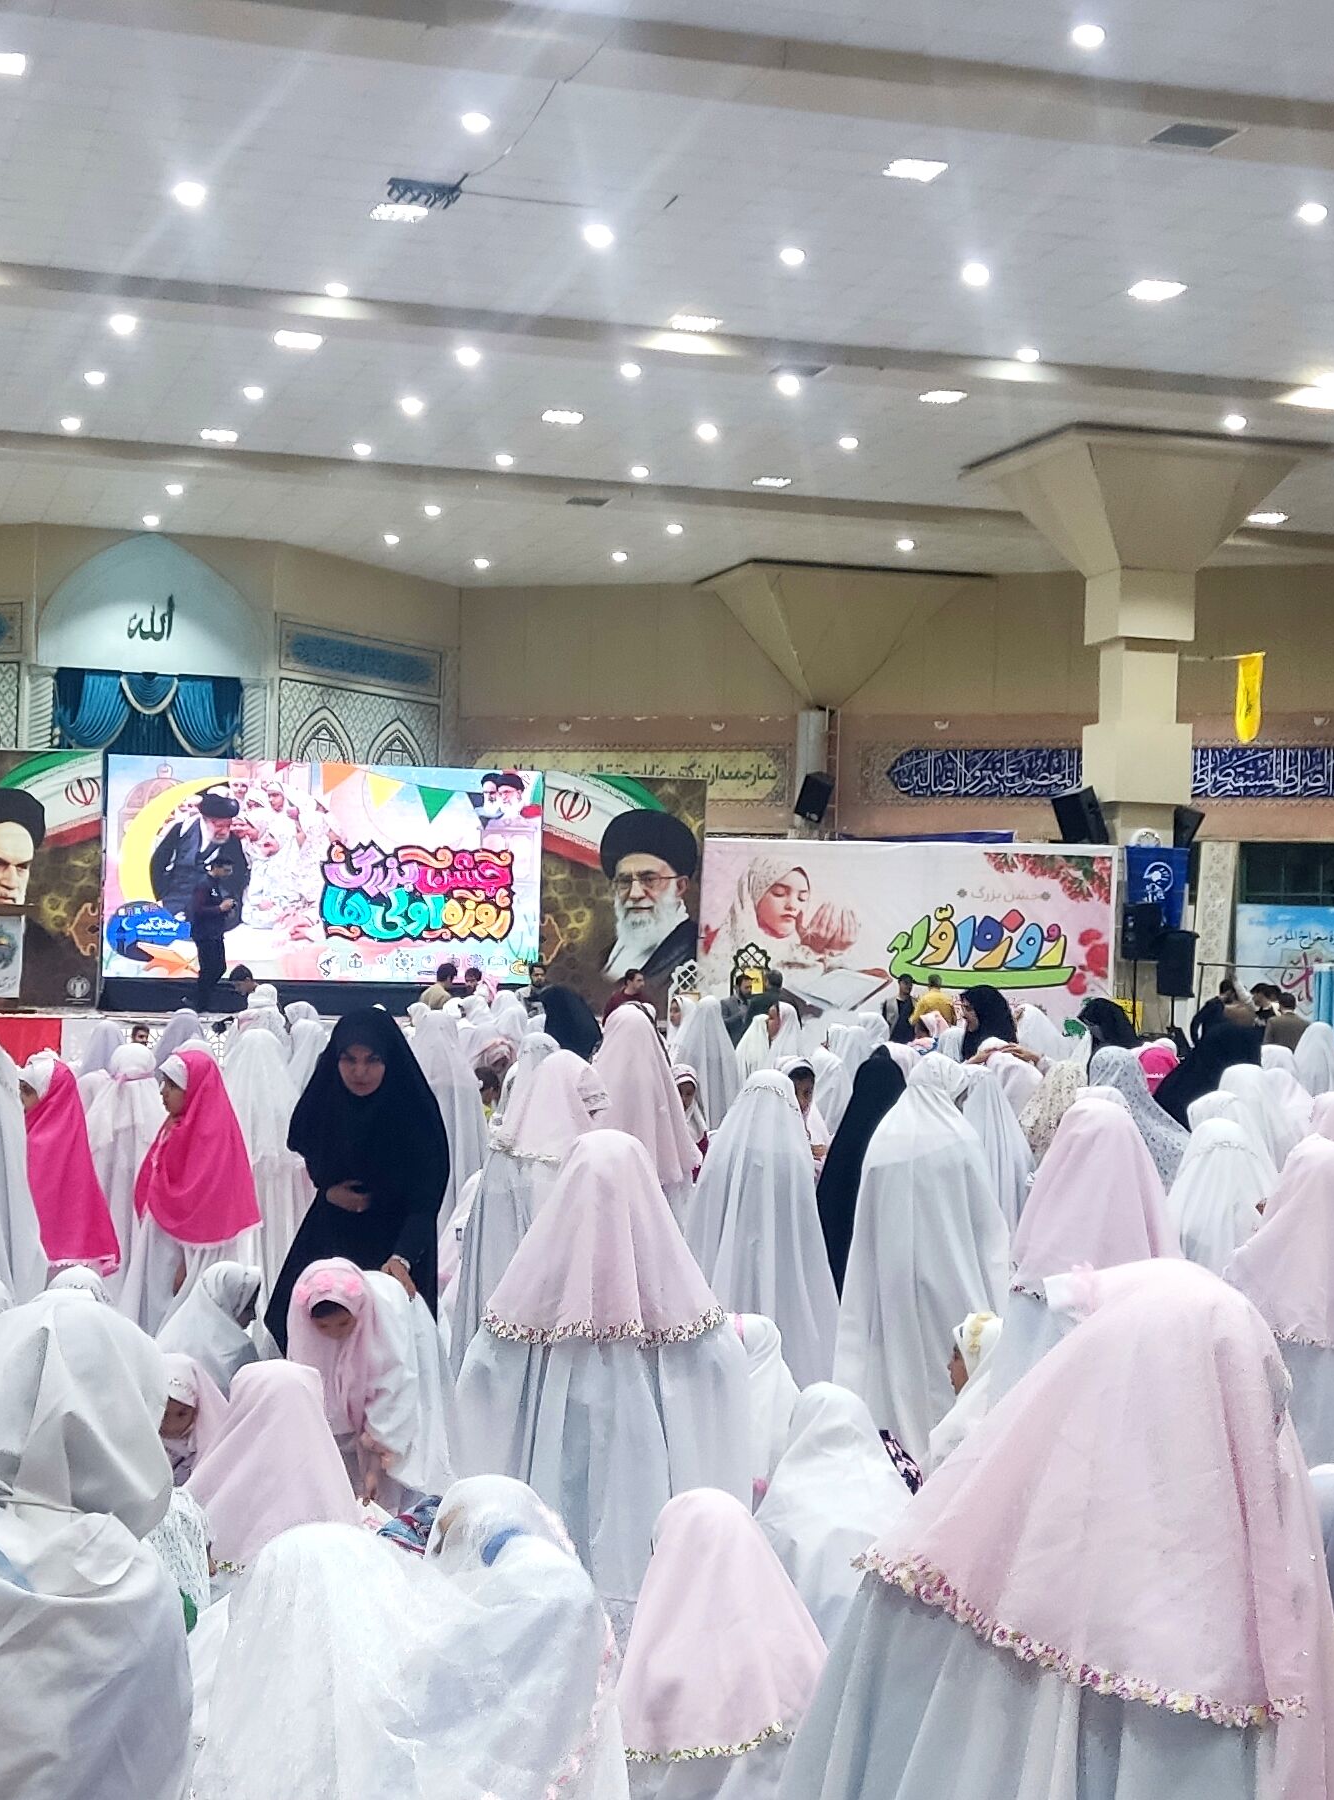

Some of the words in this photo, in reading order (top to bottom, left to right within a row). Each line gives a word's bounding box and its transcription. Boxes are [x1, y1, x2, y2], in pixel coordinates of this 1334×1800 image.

[126, 593, 176, 642] الله
[322, 841, 419, 898] بزرگ
[416, 851, 514, 898] جشن
[970, 886, 1001, 903] بزرگ
[441, 898, 513, 939] روزه
